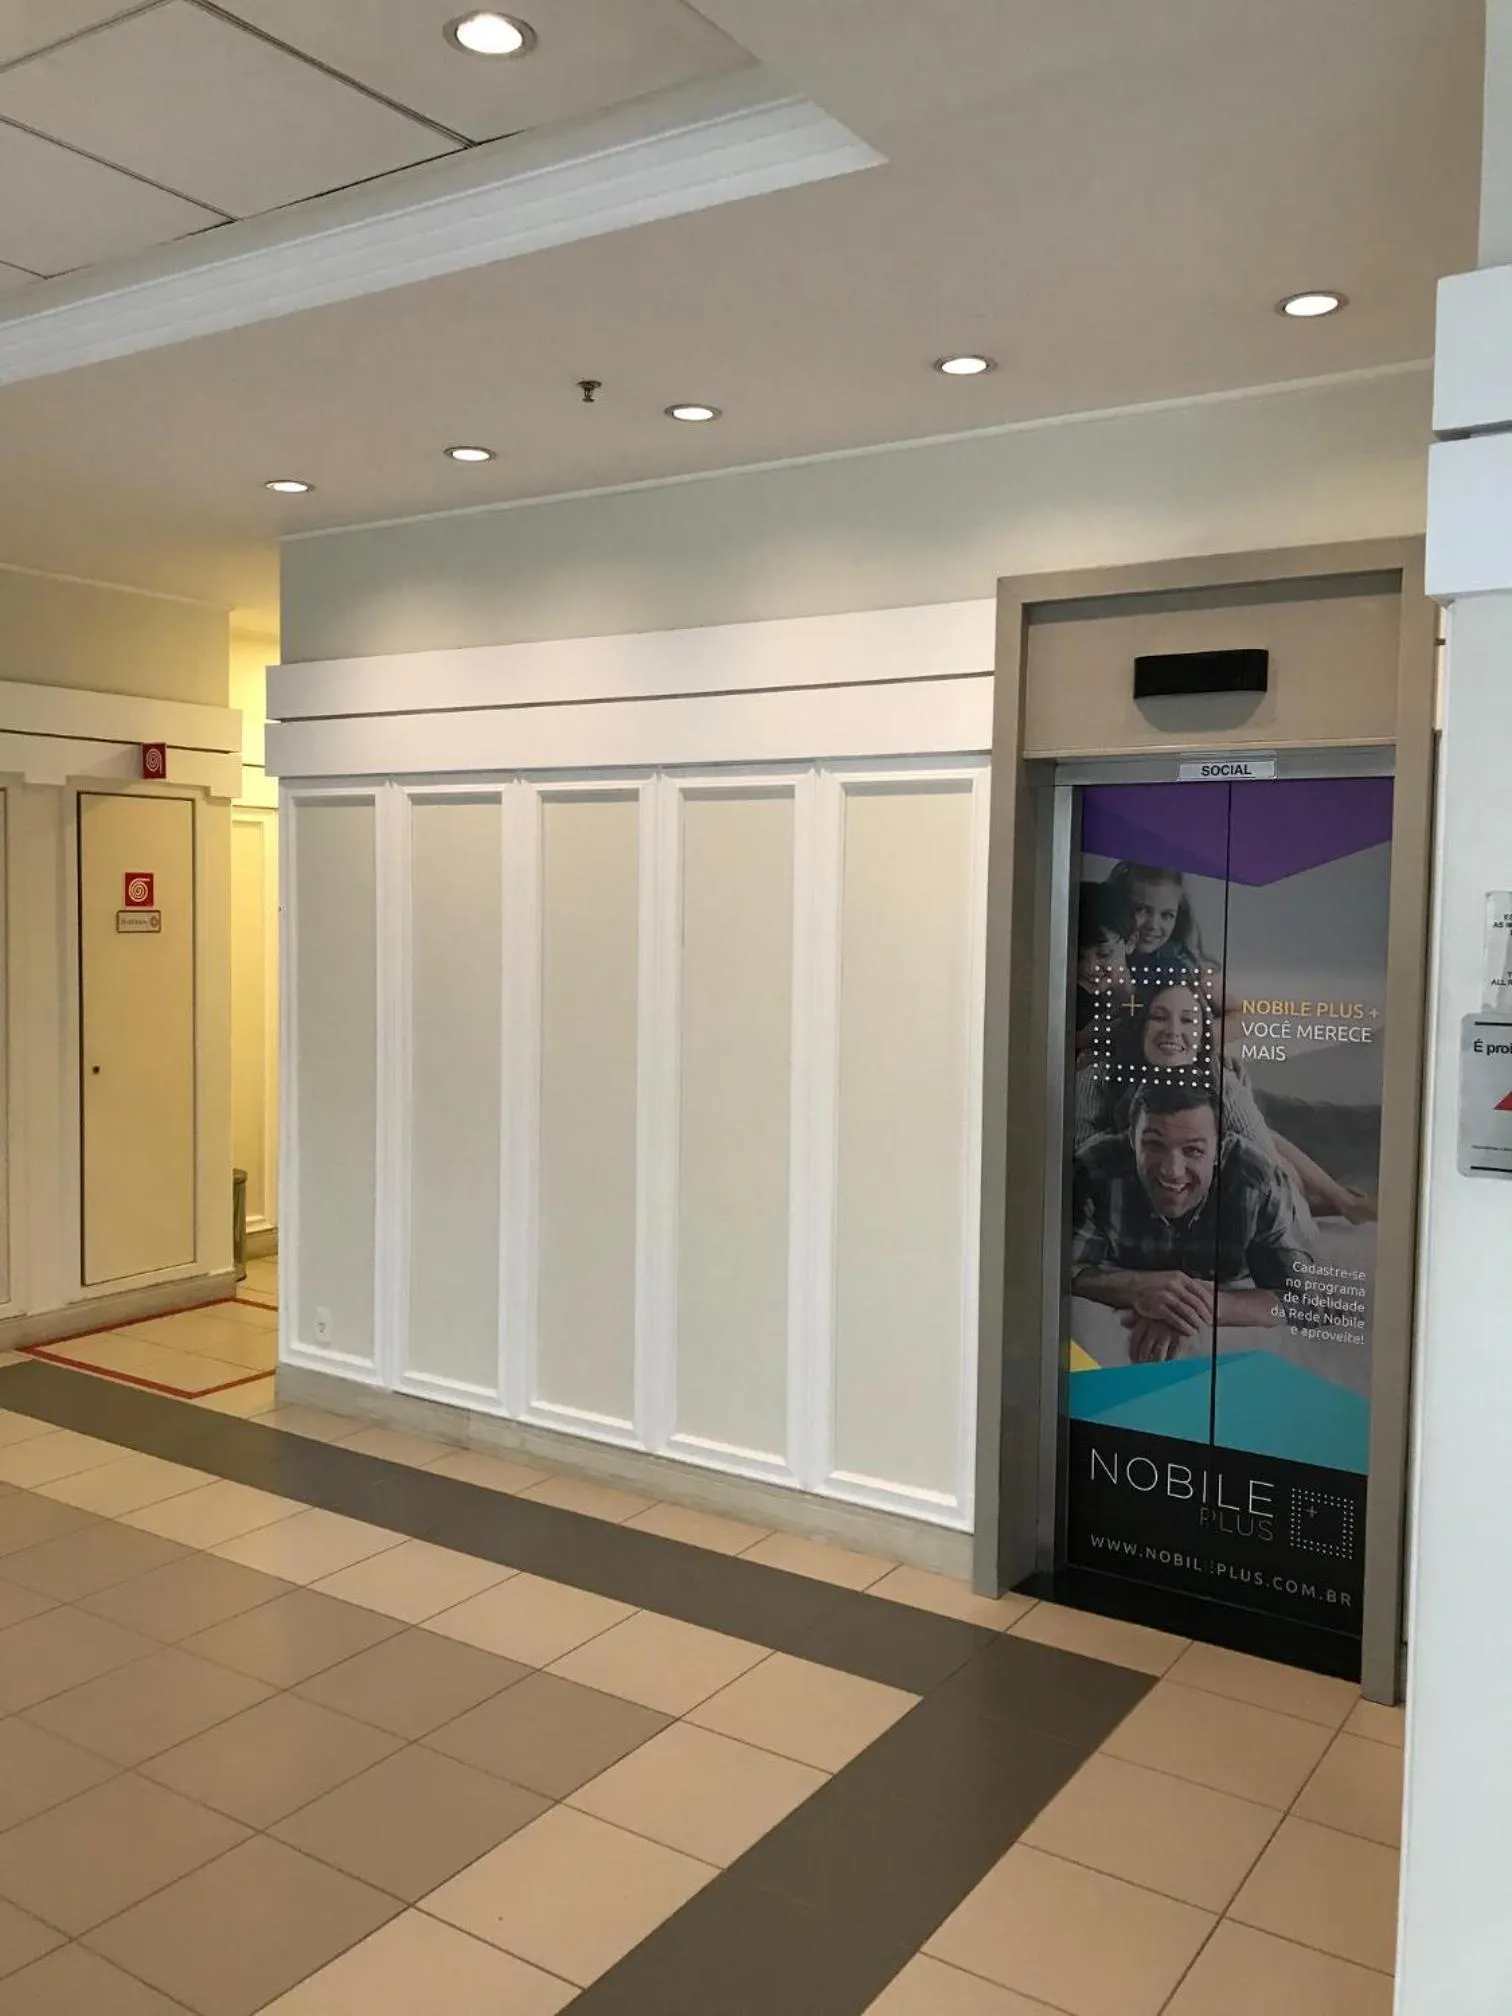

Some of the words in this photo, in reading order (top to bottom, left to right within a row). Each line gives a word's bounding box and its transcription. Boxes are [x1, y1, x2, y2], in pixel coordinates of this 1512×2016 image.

[1201, 764, 1252, 776] SOCIAL
[1242, 999, 1311, 1017] NOBILE
[1316, 1002, 1364, 1019] PLUS
[1241, 1020, 1291, 1039] VOCÊ
[1296, 1024, 1373, 1043] MERECE
[1241, 1044, 1287, 1062] MAIS
[1473, 1038, 1483, 1053] É
[1292, 1261, 1366, 1280] Cadastre-se
[1285, 1277, 1302, 1289] no
[1304, 1280, 1366, 1297] programa
[1284, 1291, 1299, 1304] de
[1302, 1293, 1365, 1313] fidelidade
[1271, 1304, 1286, 1318] da
[1288, 1307, 1320, 1323] Rede
[1323, 1312, 1365, 1329] Nobile
[1290, 1325, 1298, 1336] e
[1301, 1327, 1365, 1345] aproveite!
[1090, 1447, 1275, 1519] NOBILE
[1200, 1505, 1274, 1543] PLUS
